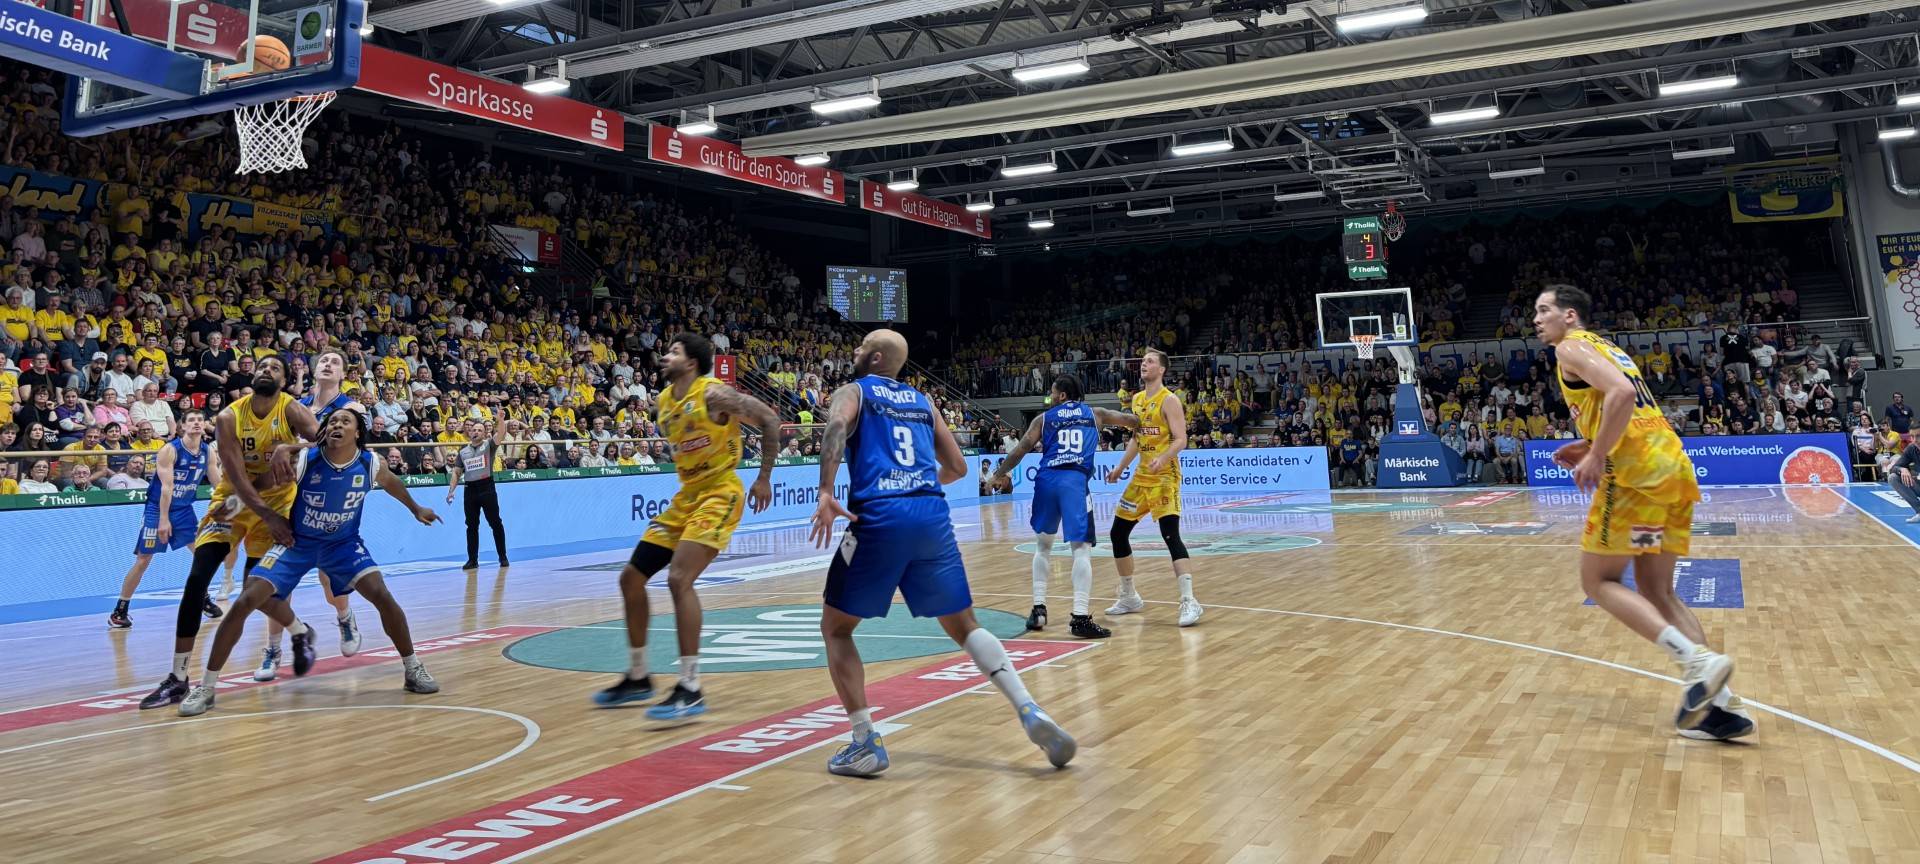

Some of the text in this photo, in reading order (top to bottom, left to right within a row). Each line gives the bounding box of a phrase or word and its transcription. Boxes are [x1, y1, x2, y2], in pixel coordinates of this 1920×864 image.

[59, 30, 111, 61] Bank
[296, 41, 322, 52] BARMER
[427, 72, 534, 120] Sparkasse
[700, 145, 811, 190] Gut für den Sport.
[901, 197, 961, 229] Gut für Hagen.
[1881, 236, 1898, 245] WIR
[1882, 245, 1905, 254] EUCH
[872, 385, 917, 404] STUCKEY
[242, 437, 256, 452] 19
[893, 425, 916, 467] 3
[1057, 429, 1083, 454] 99
[1708, 445, 1783, 456] Werbedruck
[1227, 455, 1300, 467] Kandidaten
[1384, 457, 1440, 468] Märkische
[412, 476, 434, 485] Thalia
[517, 471, 537, 479] Thalia
[1220, 473, 1268, 485] Service
[1400, 471, 1427, 482] Bank
[49, 494, 86, 505] Thalia
[304, 506, 355, 522] WUNDER
[302, 515, 325, 530] BAR
